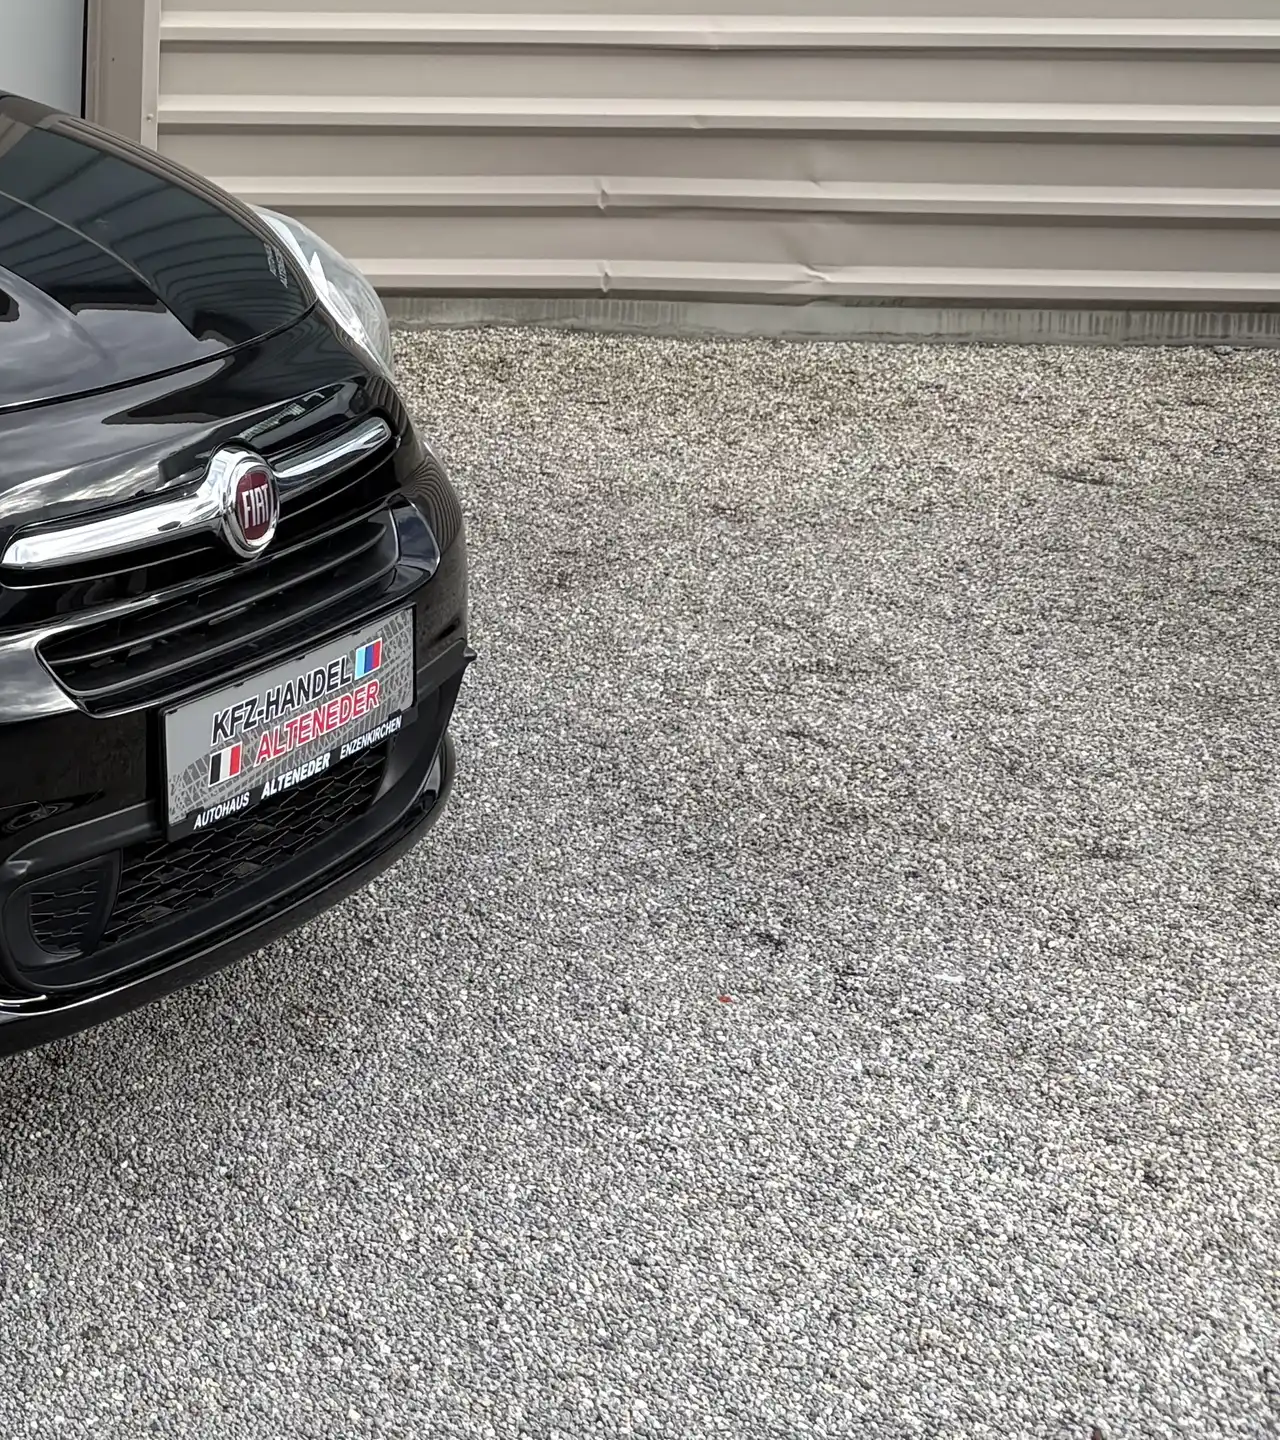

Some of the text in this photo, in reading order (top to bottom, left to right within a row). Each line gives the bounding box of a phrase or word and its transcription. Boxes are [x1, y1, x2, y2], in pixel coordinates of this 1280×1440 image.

[241, 482, 270, 530] FIAT
[210, 655, 354, 747] KFZ-HANDEL
[253, 679, 381, 768] ALTENEDER
[193, 714, 403, 830] AUTOHAUS ALTENEDER ENZENKIRCHEN
